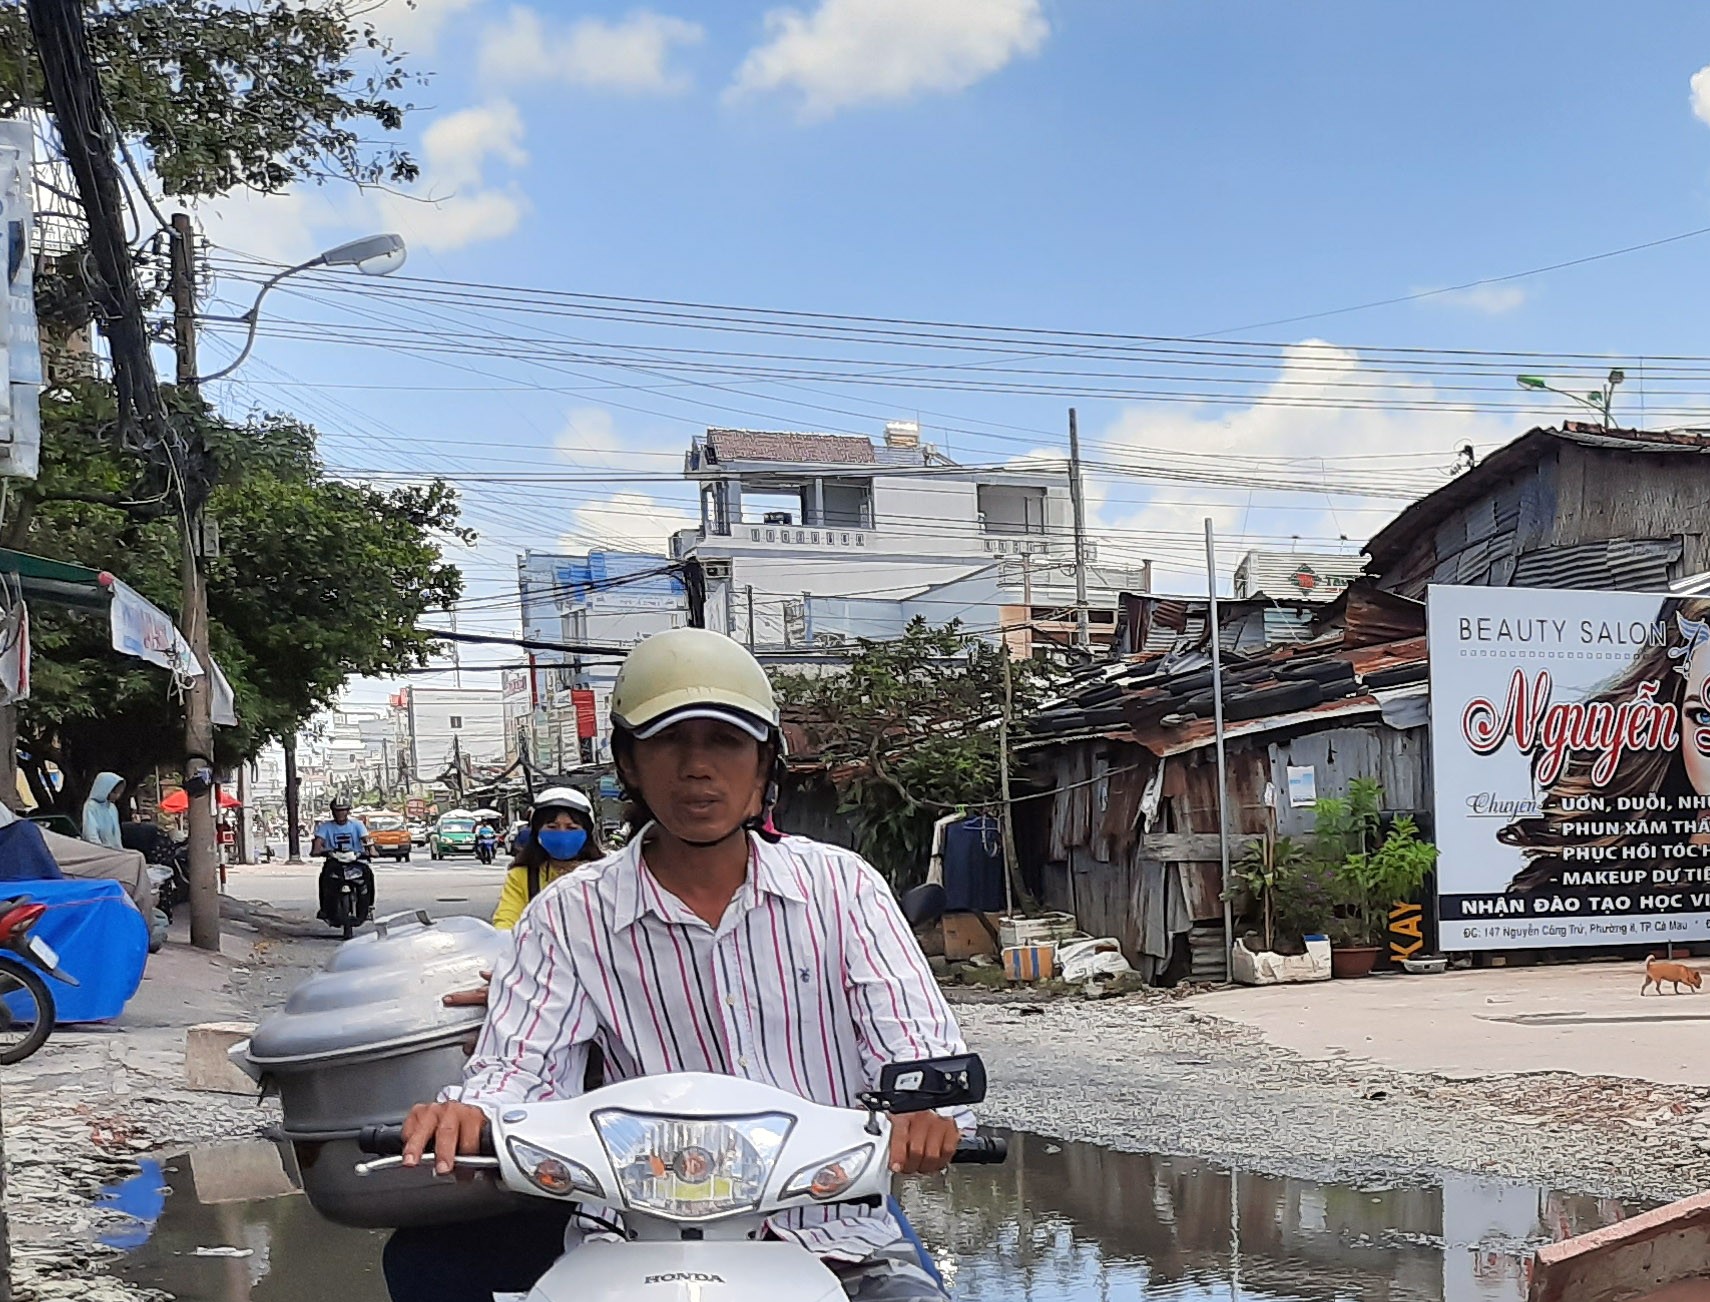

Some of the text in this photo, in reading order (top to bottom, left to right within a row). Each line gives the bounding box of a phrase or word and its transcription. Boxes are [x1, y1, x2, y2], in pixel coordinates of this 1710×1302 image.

[1459, 617, 1667, 646] BEAUTY SALON
[1461, 666, 1679, 787] Nguyễn
[1562, 820, 1620, 836] PHUN
[1563, 846, 1617, 863] PHỤC
[1563, 870, 1647, 885] MAKEUP
[1652, 867, 1682, 885] DỰ
[1461, 897, 1525, 916] NHẬN
[1533, 894, 1580, 913] ĐÀO
[1588, 896, 1631, 914] TẠO
[1639, 894, 1682, 912] HỌC
[1640, 921, 1652, 932] TP
[644, 1272, 726, 1284] HONDA
